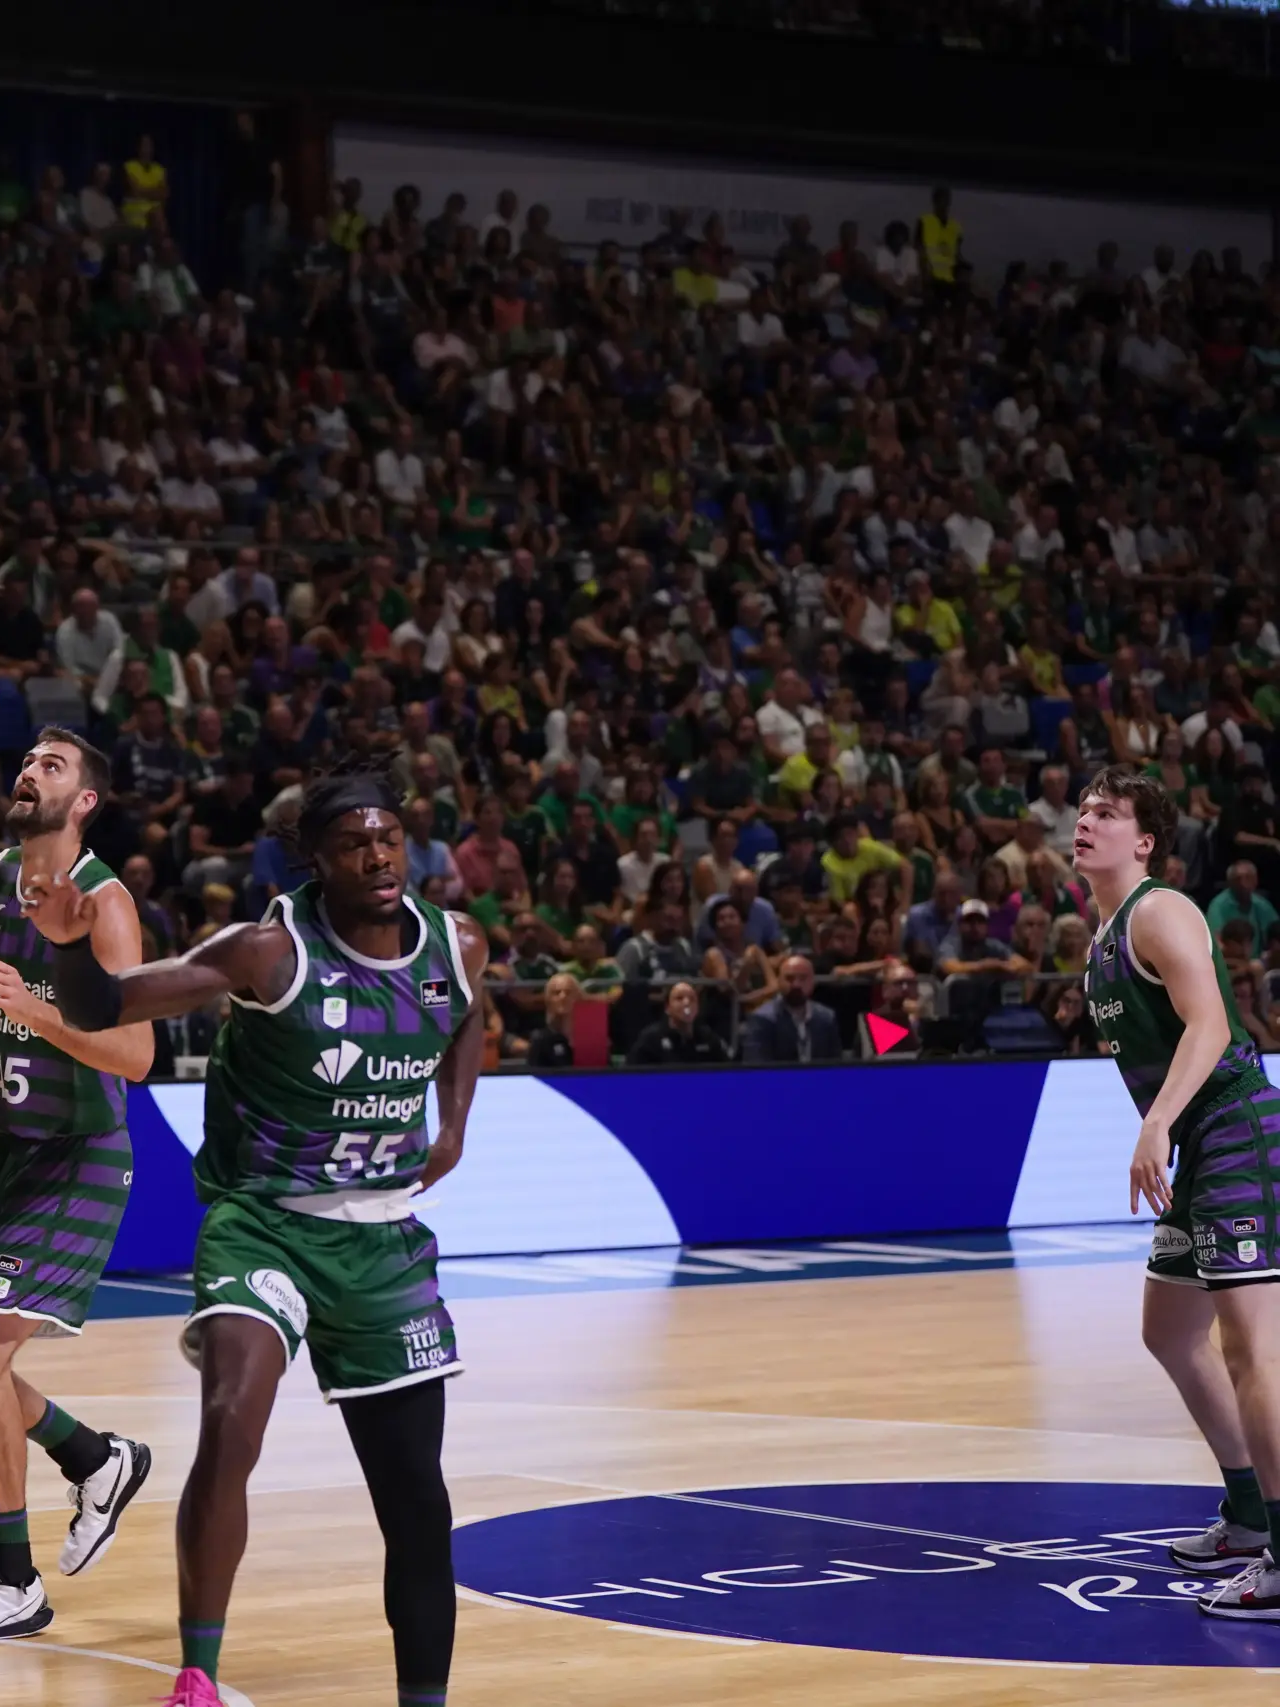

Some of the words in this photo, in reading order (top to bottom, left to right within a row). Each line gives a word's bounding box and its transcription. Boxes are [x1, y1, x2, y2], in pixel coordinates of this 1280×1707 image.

[366, 1051, 442, 1081] Unicaj
[331, 1094, 424, 1124] málaga
[323, 1132, 406, 1183] 55
[1235, 1224, 1252, 1232] acb
[0, 1259, 16, 1271] acb
[1197, 1247, 1219, 1266] aga
